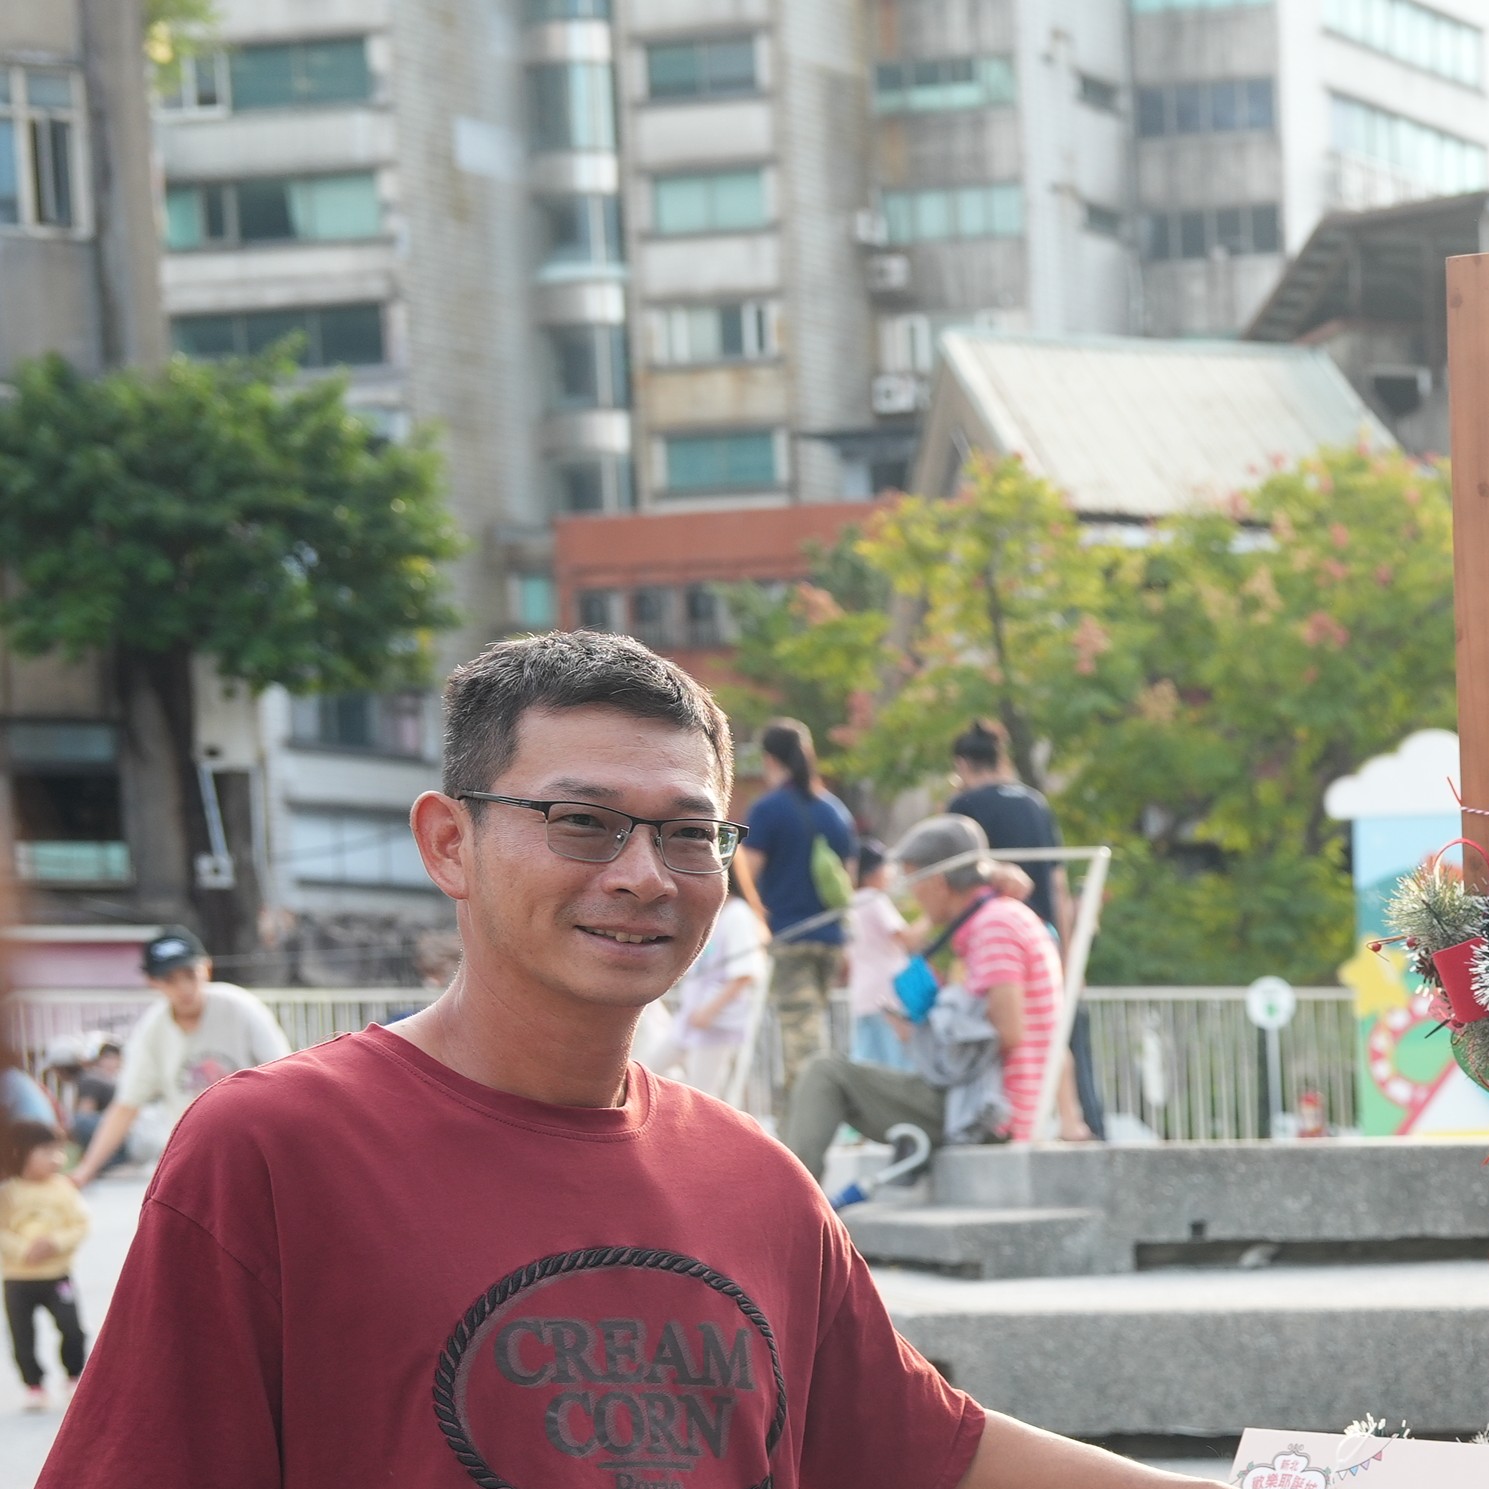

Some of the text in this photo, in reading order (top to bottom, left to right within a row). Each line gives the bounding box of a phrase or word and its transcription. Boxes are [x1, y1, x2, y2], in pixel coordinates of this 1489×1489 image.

[494, 1317, 756, 1391] CREAM
[544, 1391, 738, 1460] CORN
[1281, 1458, 1300, 1472] 新北
